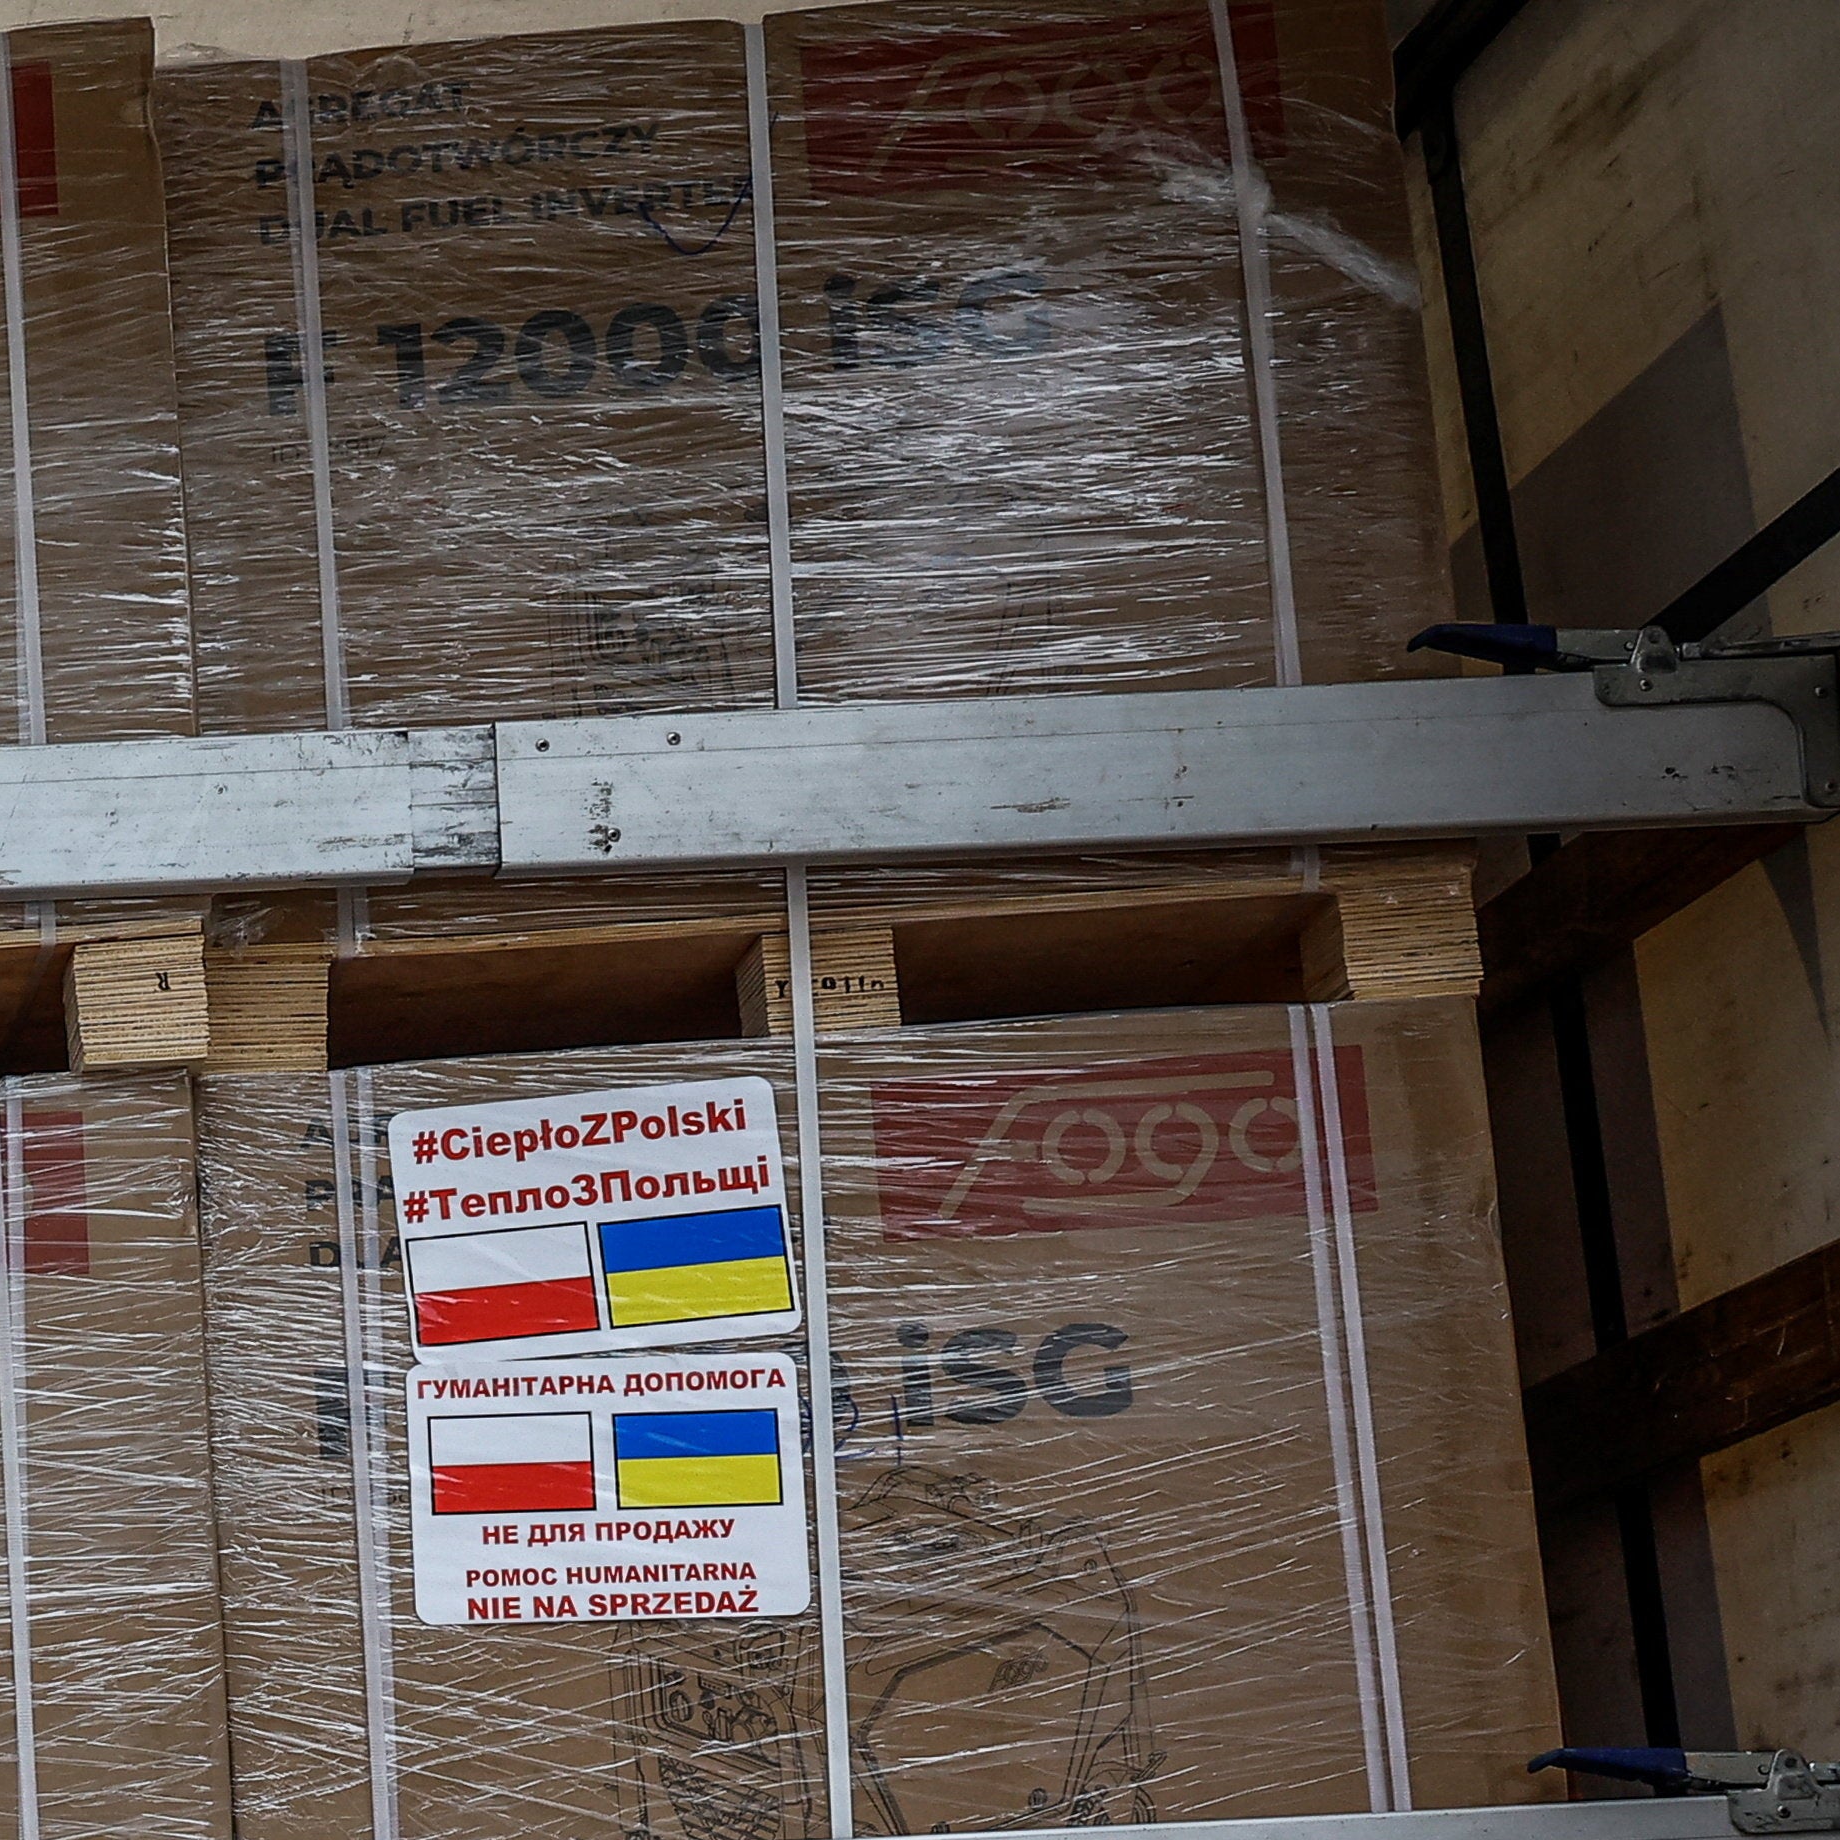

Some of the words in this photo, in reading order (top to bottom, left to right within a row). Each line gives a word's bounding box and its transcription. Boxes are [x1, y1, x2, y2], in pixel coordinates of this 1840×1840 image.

[401, 194, 504, 234] FUEL
[412, 1098, 748, 1164] #CiepłoZPolski
[403, 1155, 771, 1224] #ТеплоЗПольщі
[416, 1373, 615, 1400] ГУМАНІТАРНА
[622, 1367, 787, 1398] ДОПОМОГА
[897, 1321, 1135, 1428] iSG
[481, 1524, 519, 1545] НЕ
[527, 1521, 586, 1548] ДЛЯ
[594, 1517, 736, 1543] ПРОДАЖУ
[465, 1566, 558, 1588] POMOC
[565, 1560, 757, 1586] HUMANITARNA
[467, 1596, 521, 1621] NIE
[532, 1593, 578, 1619] NA
[588, 1583, 760, 1616] SPRZEDAŻ
